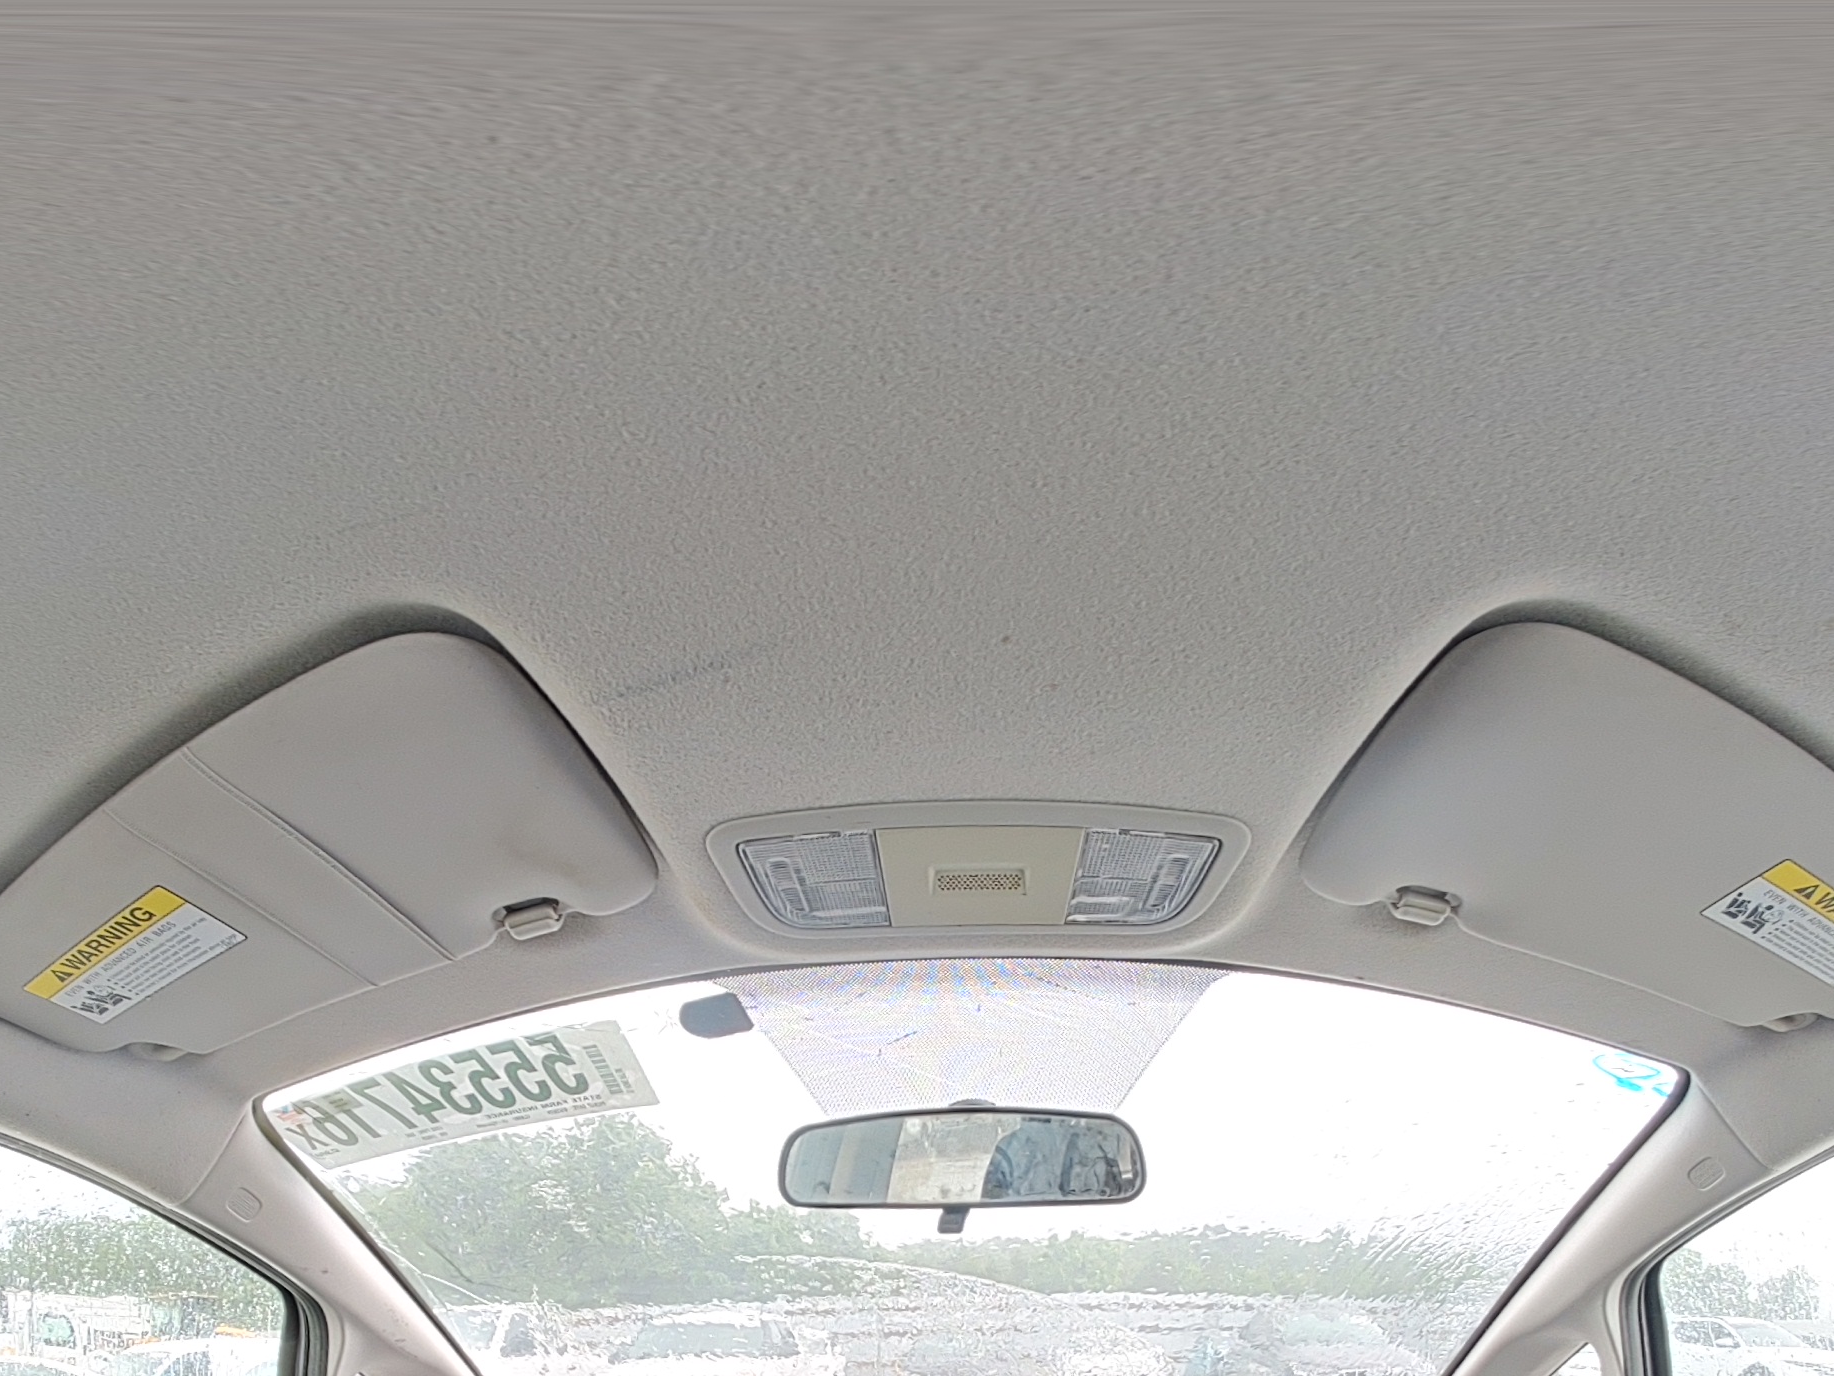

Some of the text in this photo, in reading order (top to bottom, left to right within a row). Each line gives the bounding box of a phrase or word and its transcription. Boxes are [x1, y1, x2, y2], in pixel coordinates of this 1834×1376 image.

[1764, 890, 1786, 905] EVEN
[1786, 903, 1808, 918] WITH
[60, 906, 156, 971] WARNING
[102, 947, 137, 973] ADVANCED
[154, 921, 177, 937] BAGS
